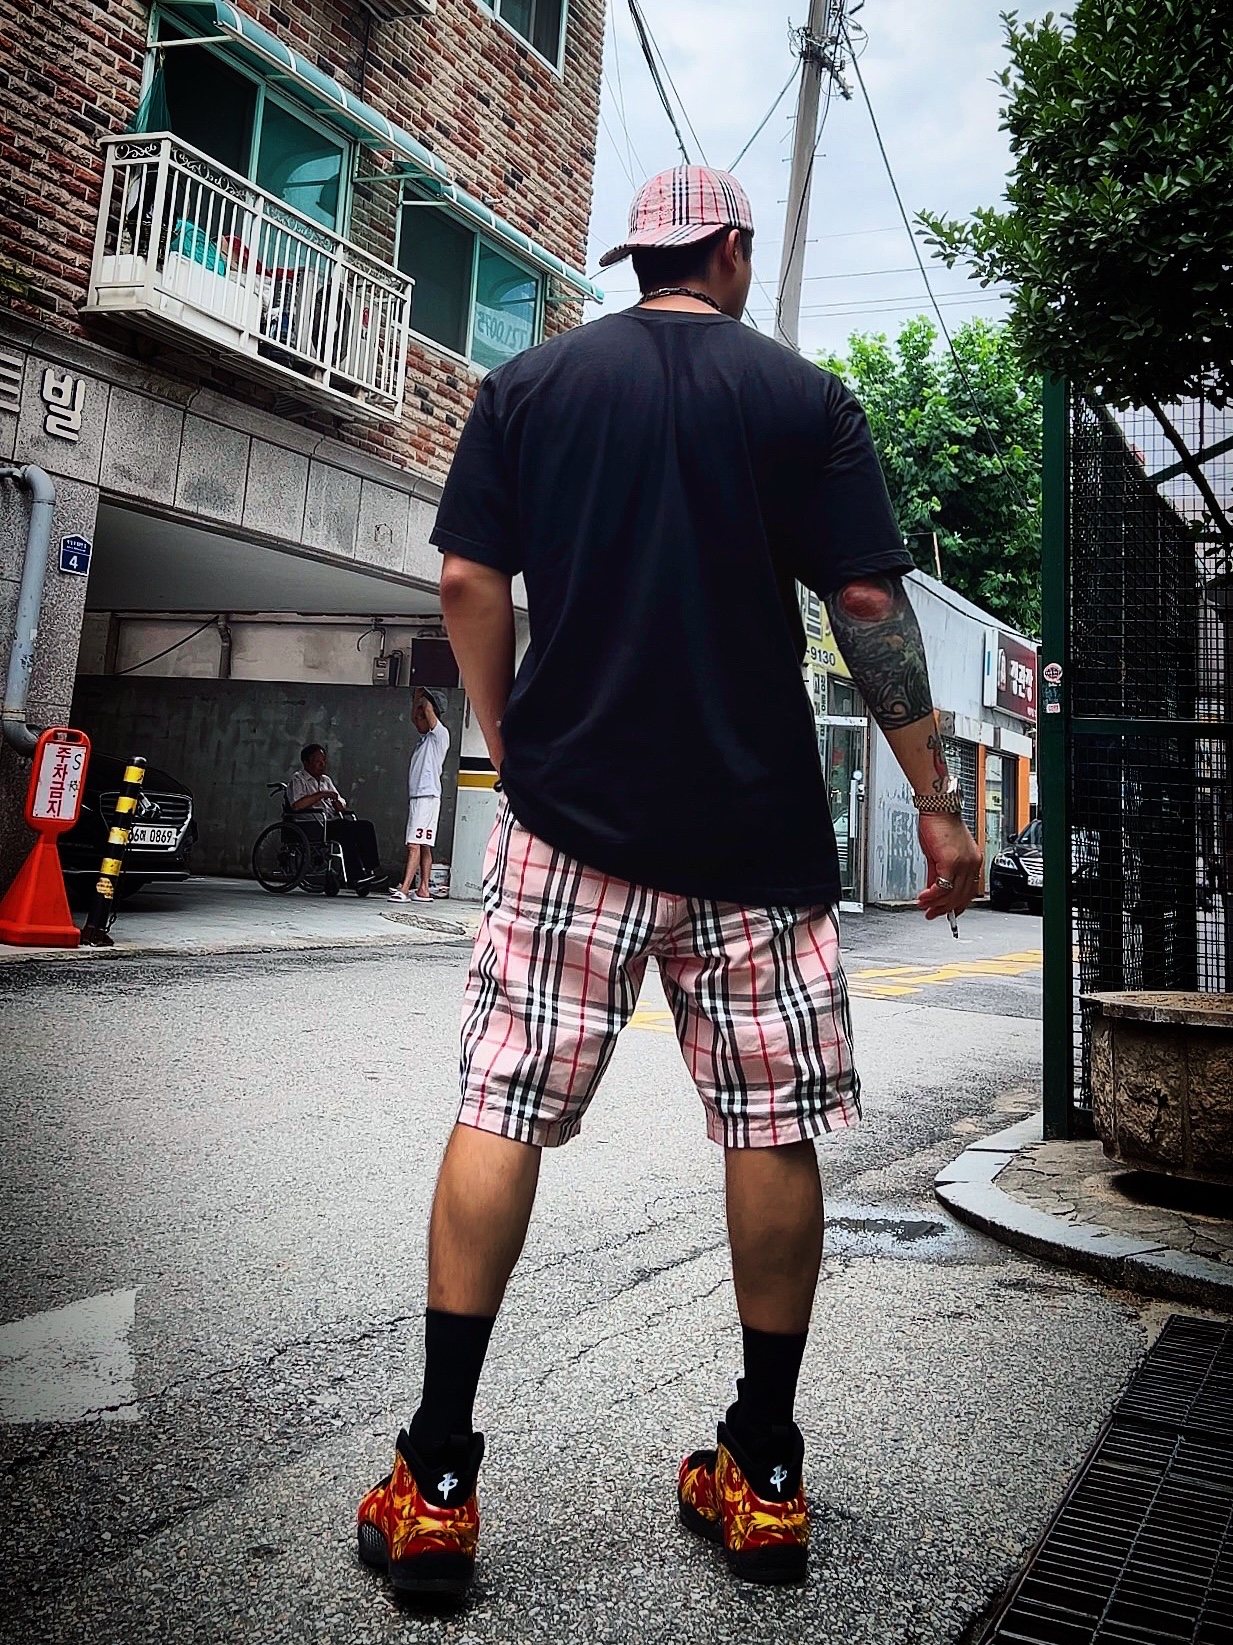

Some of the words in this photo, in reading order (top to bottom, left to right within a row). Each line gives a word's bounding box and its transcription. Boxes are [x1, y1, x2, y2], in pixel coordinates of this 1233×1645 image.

[69, 555, 79, 569] 4
[46, 747, 72, 817] 주차금지
[150, 829, 172, 843] 0869
[415, 828, 433, 840] 36
